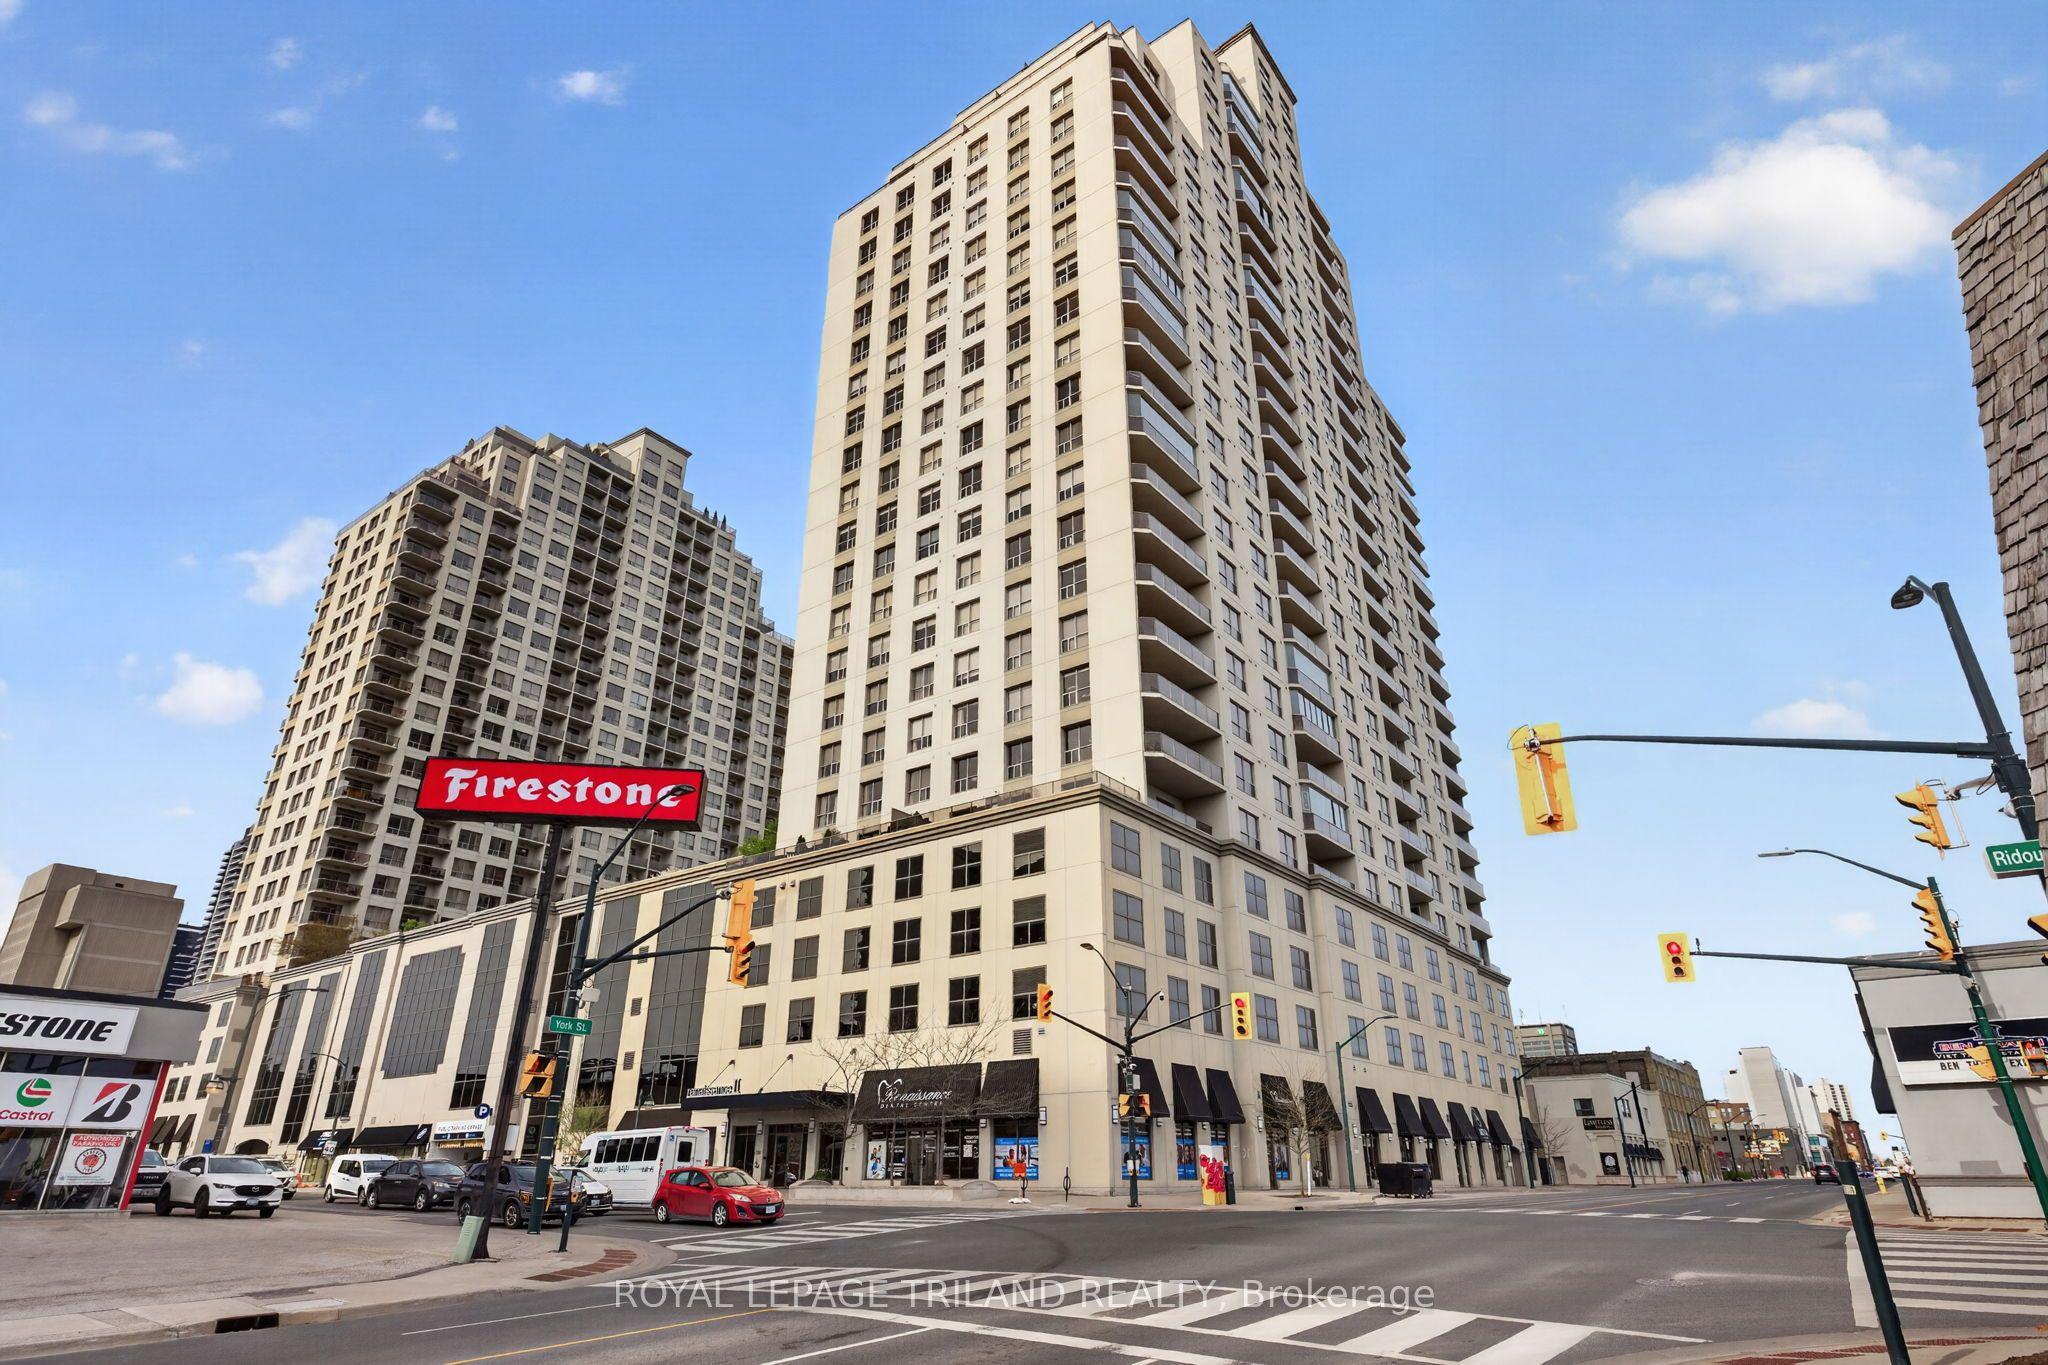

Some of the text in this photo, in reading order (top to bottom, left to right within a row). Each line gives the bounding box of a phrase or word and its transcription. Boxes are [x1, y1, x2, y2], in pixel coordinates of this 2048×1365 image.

[444, 768, 682, 808] Firestone
[556, 1020, 573, 1030] York
[1940, 1061, 1960, 1071] BEN
[884, 1087, 953, 1102] Renaissance
[0, 1109, 54, 1121] Castrol
[479, 1106, 488, 1116] P
